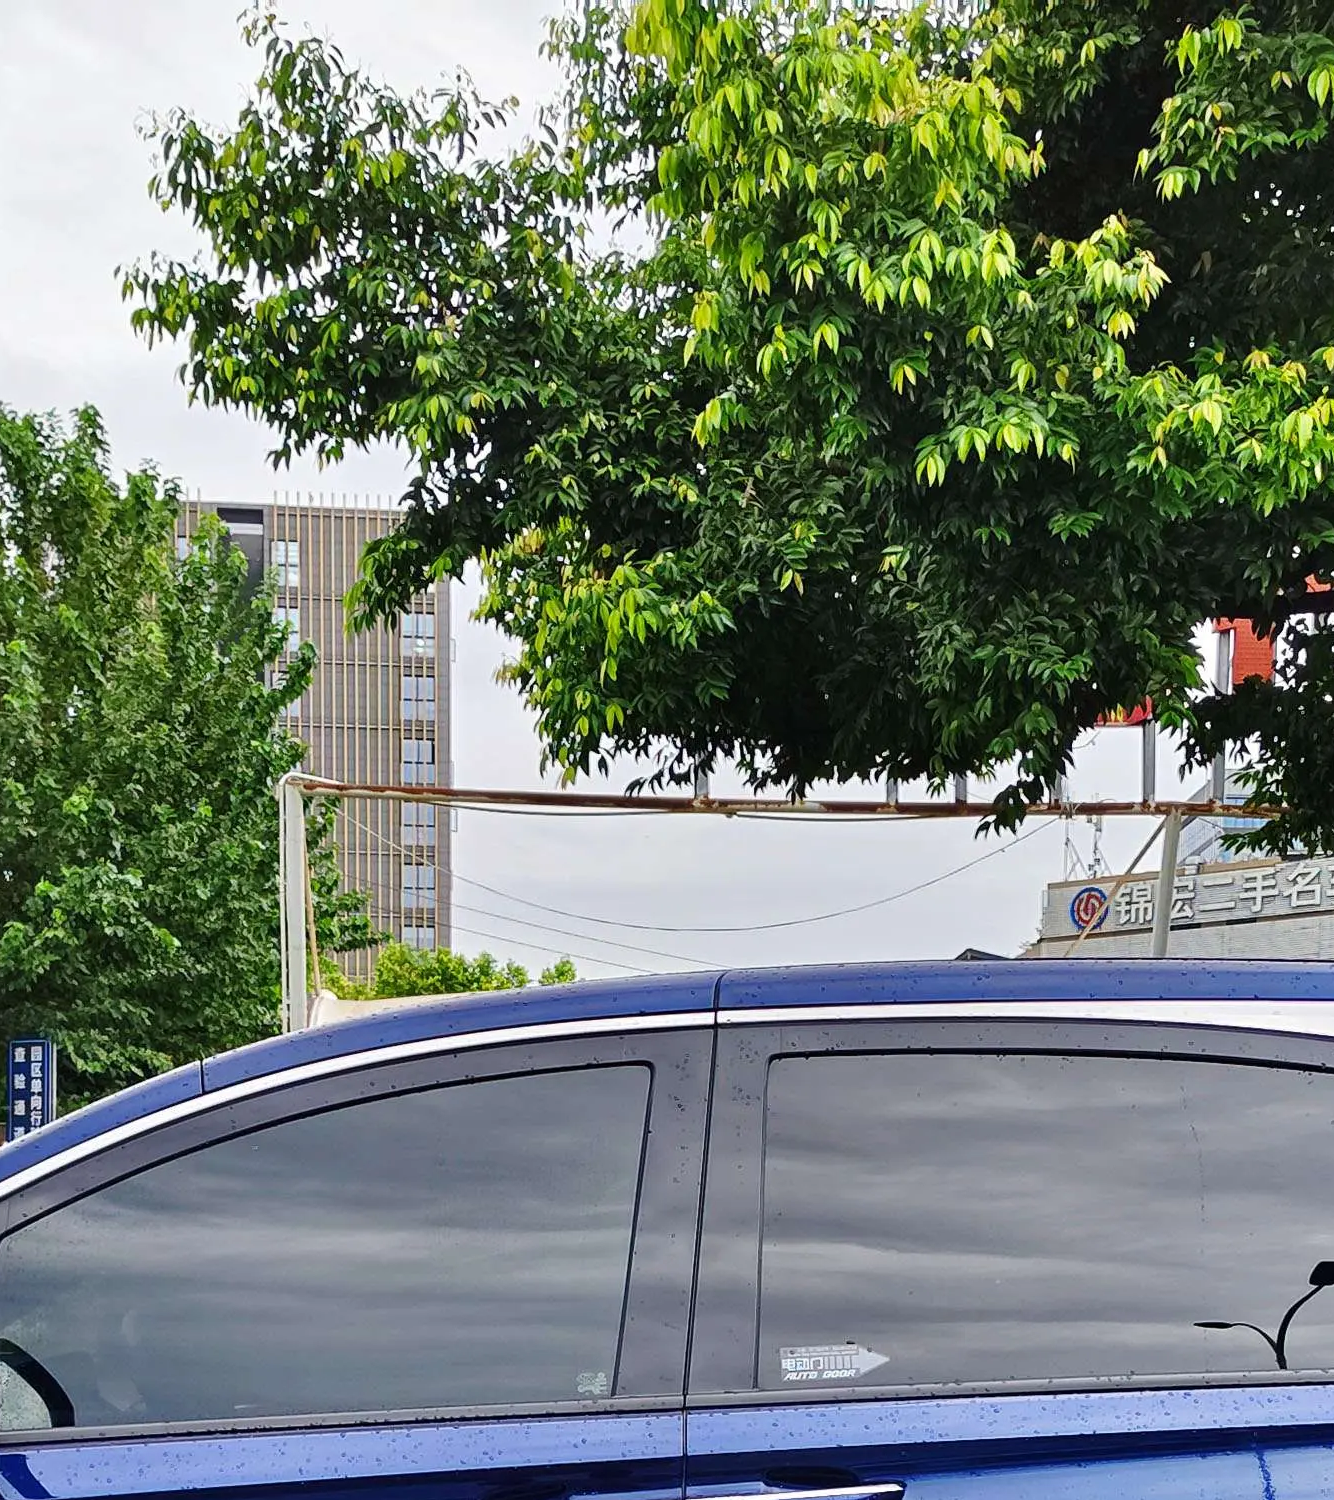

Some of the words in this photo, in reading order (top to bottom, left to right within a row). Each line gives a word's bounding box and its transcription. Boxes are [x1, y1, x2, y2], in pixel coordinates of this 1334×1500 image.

[30, 1045, 43, 1132] 园区单向行
[783, 1371, 818, 1380] AUTO
